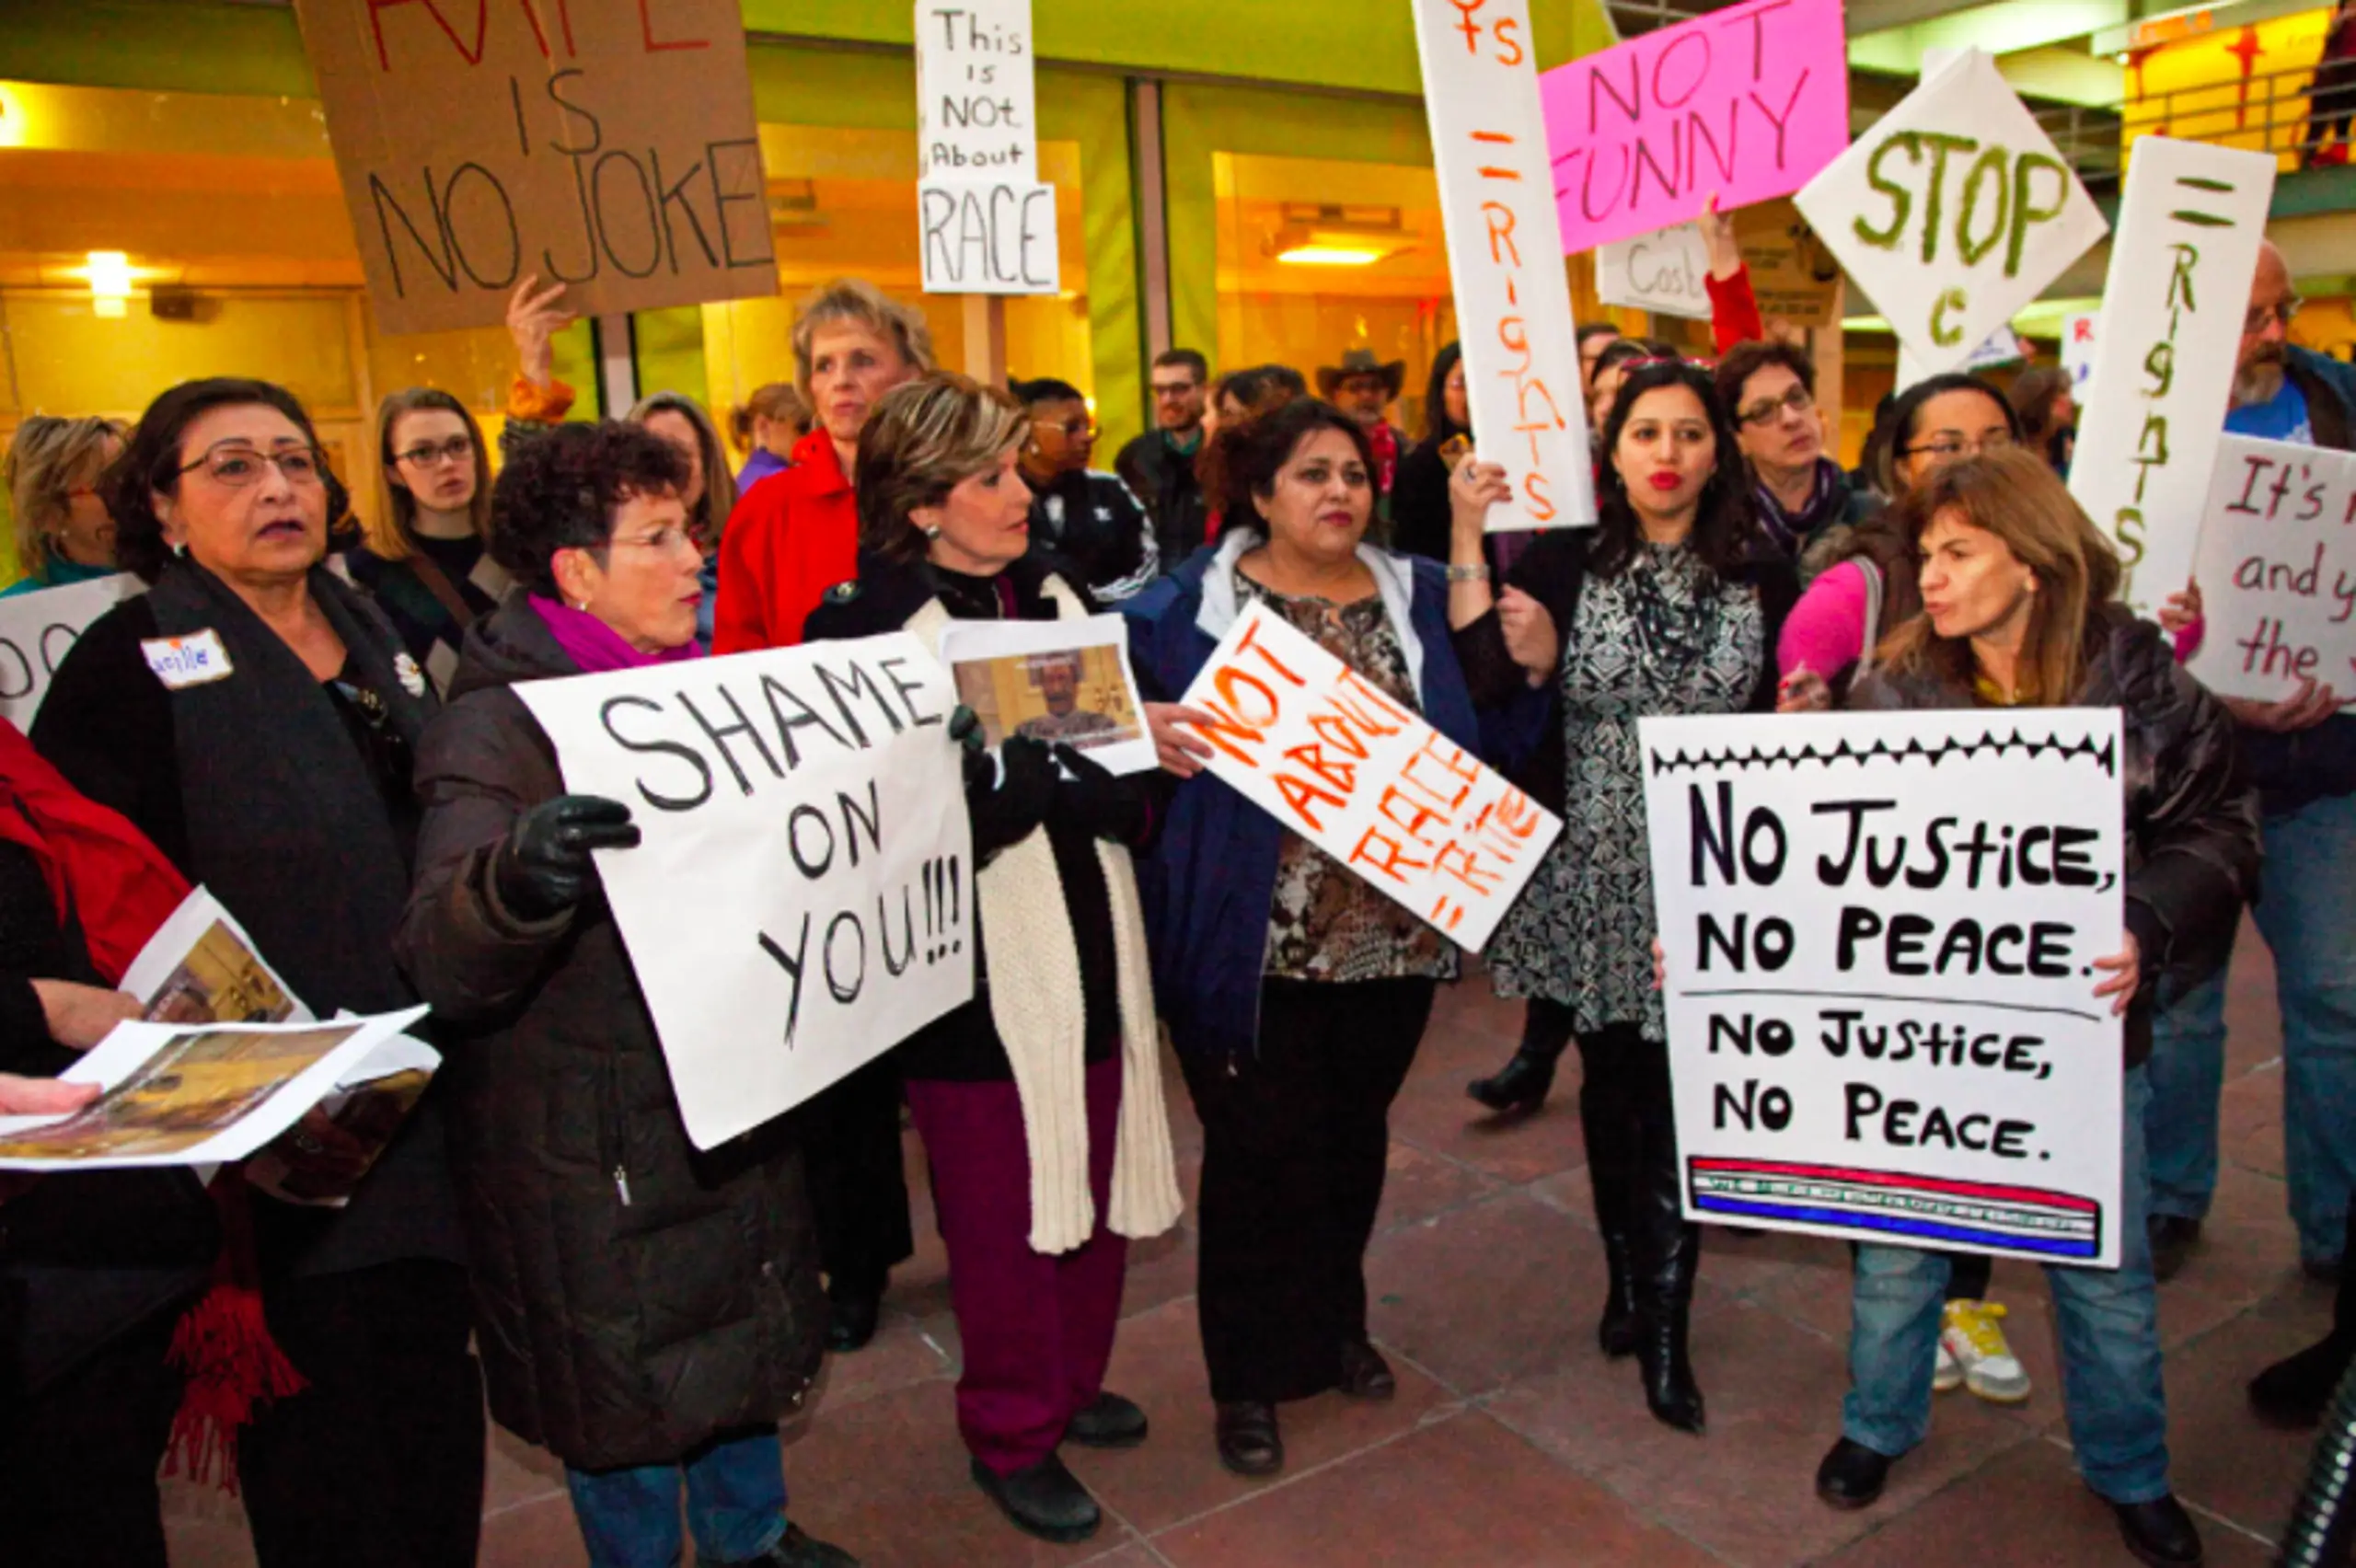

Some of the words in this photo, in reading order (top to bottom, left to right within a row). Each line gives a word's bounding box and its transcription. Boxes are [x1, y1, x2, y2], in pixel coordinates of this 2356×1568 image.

[931, 9, 1023, 55] This
[1588, 1, 1792, 135] NOT
[509, 68, 602, 156] IS
[931, 143, 1025, 168] About
[368, 162, 522, 299] NO
[543, 138, 776, 285] JOKE
[922, 184, 1052, 286] RACE
[1853, 131, 2071, 278] STOP
[2224, 454, 2327, 522] It's
[1189, 618, 1307, 768] NOT
[2236, 617, 2319, 679] the
[599, 657, 943, 811] SHAME
[1271, 664, 1413, 834] ABOUT
[789, 778, 881, 881] ON
[1348, 730, 1484, 885] RACE
[1689, 780, 1788, 886] NO
[757, 855, 963, 1051] YOU!!!
[1696, 914, 1795, 973] NO
[1836, 906, 2094, 976] PEACE.
[1708, 1013, 1794, 1057] NO
[1714, 1078, 1793, 1132] NO
[1843, 1081, 2051, 1160] PEACE.
